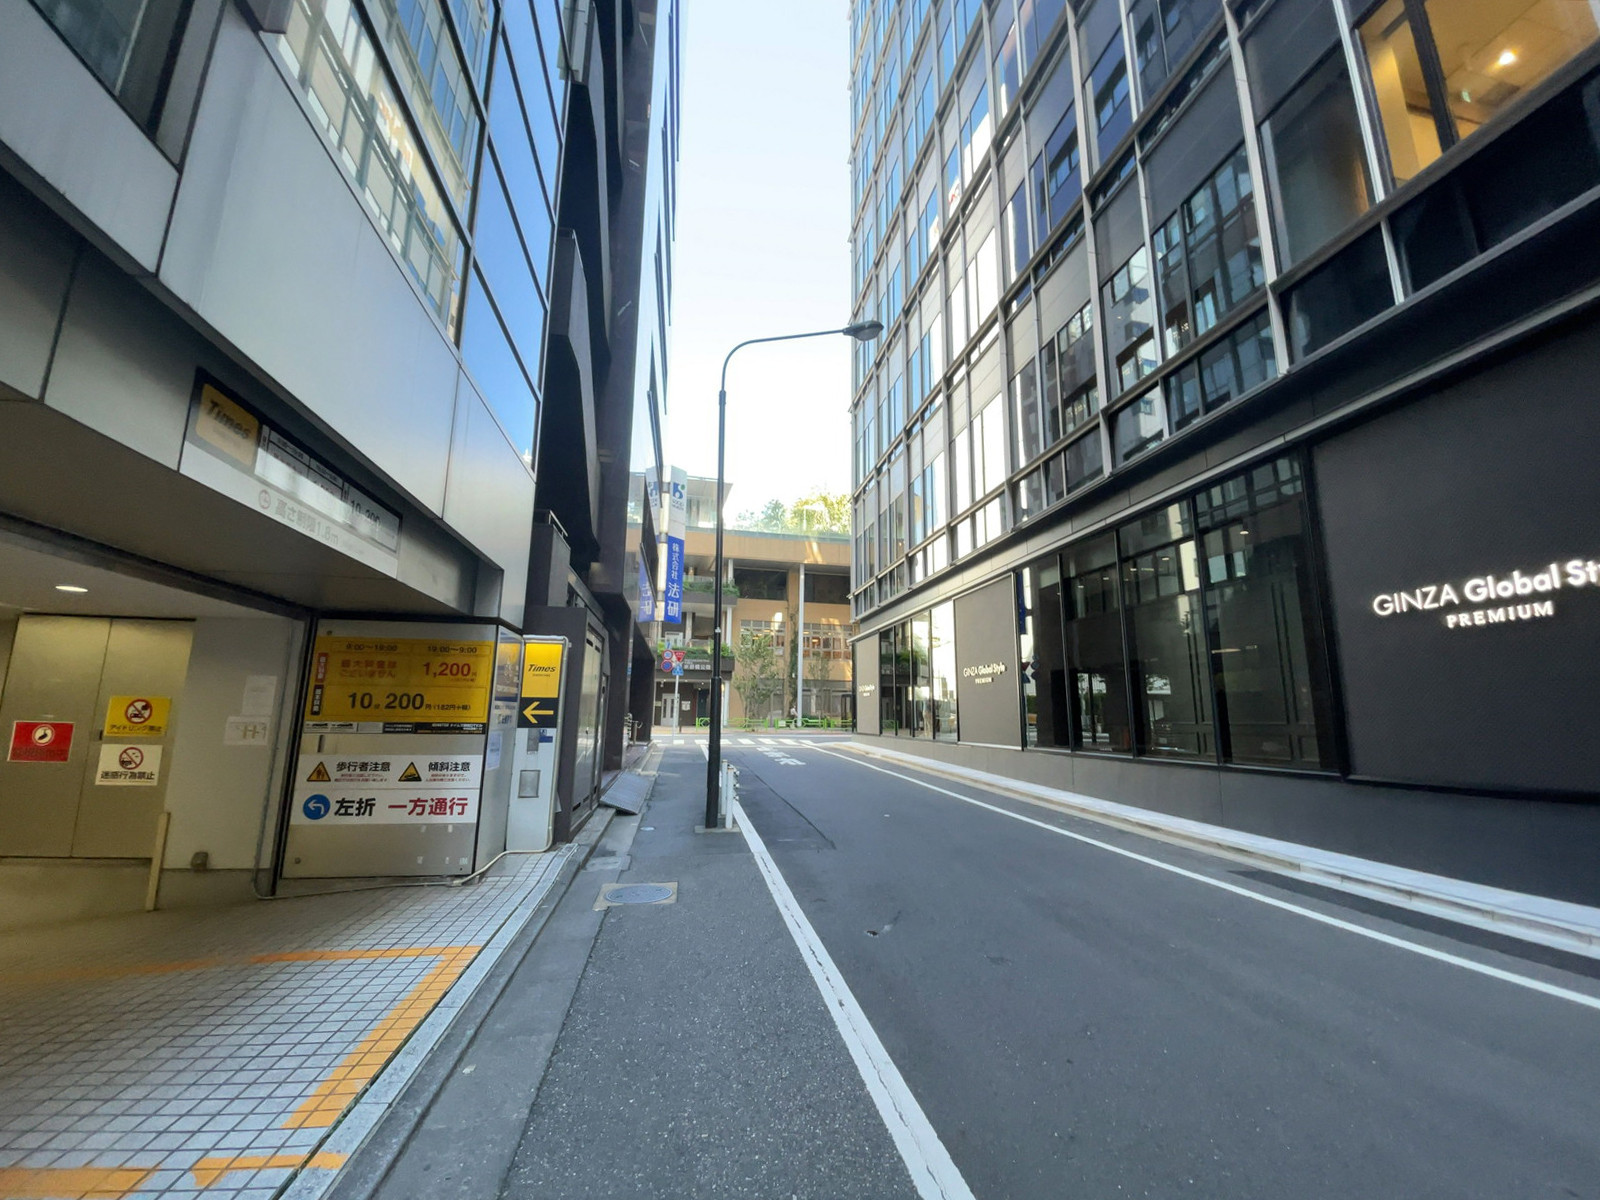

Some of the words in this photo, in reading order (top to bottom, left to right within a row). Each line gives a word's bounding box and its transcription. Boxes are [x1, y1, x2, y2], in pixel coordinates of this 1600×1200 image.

[206, 400, 252, 440] Times
[1372, 583, 1460, 616] GINZA
[1464, 562, 1561, 603] Global
[1565, 559, 1600, 586] St
[1446, 600, 1554, 629] PREMIUM
[528, 664, 556, 673] Times
[100, 771, 155, 780] 迷惑行為禁止
[336, 762, 391, 772] 歩行者注意
[428, 762, 471, 773] 傾斜注意
[334, 798, 376, 816] 左折
[388, 797, 468, 816] 一方通行
